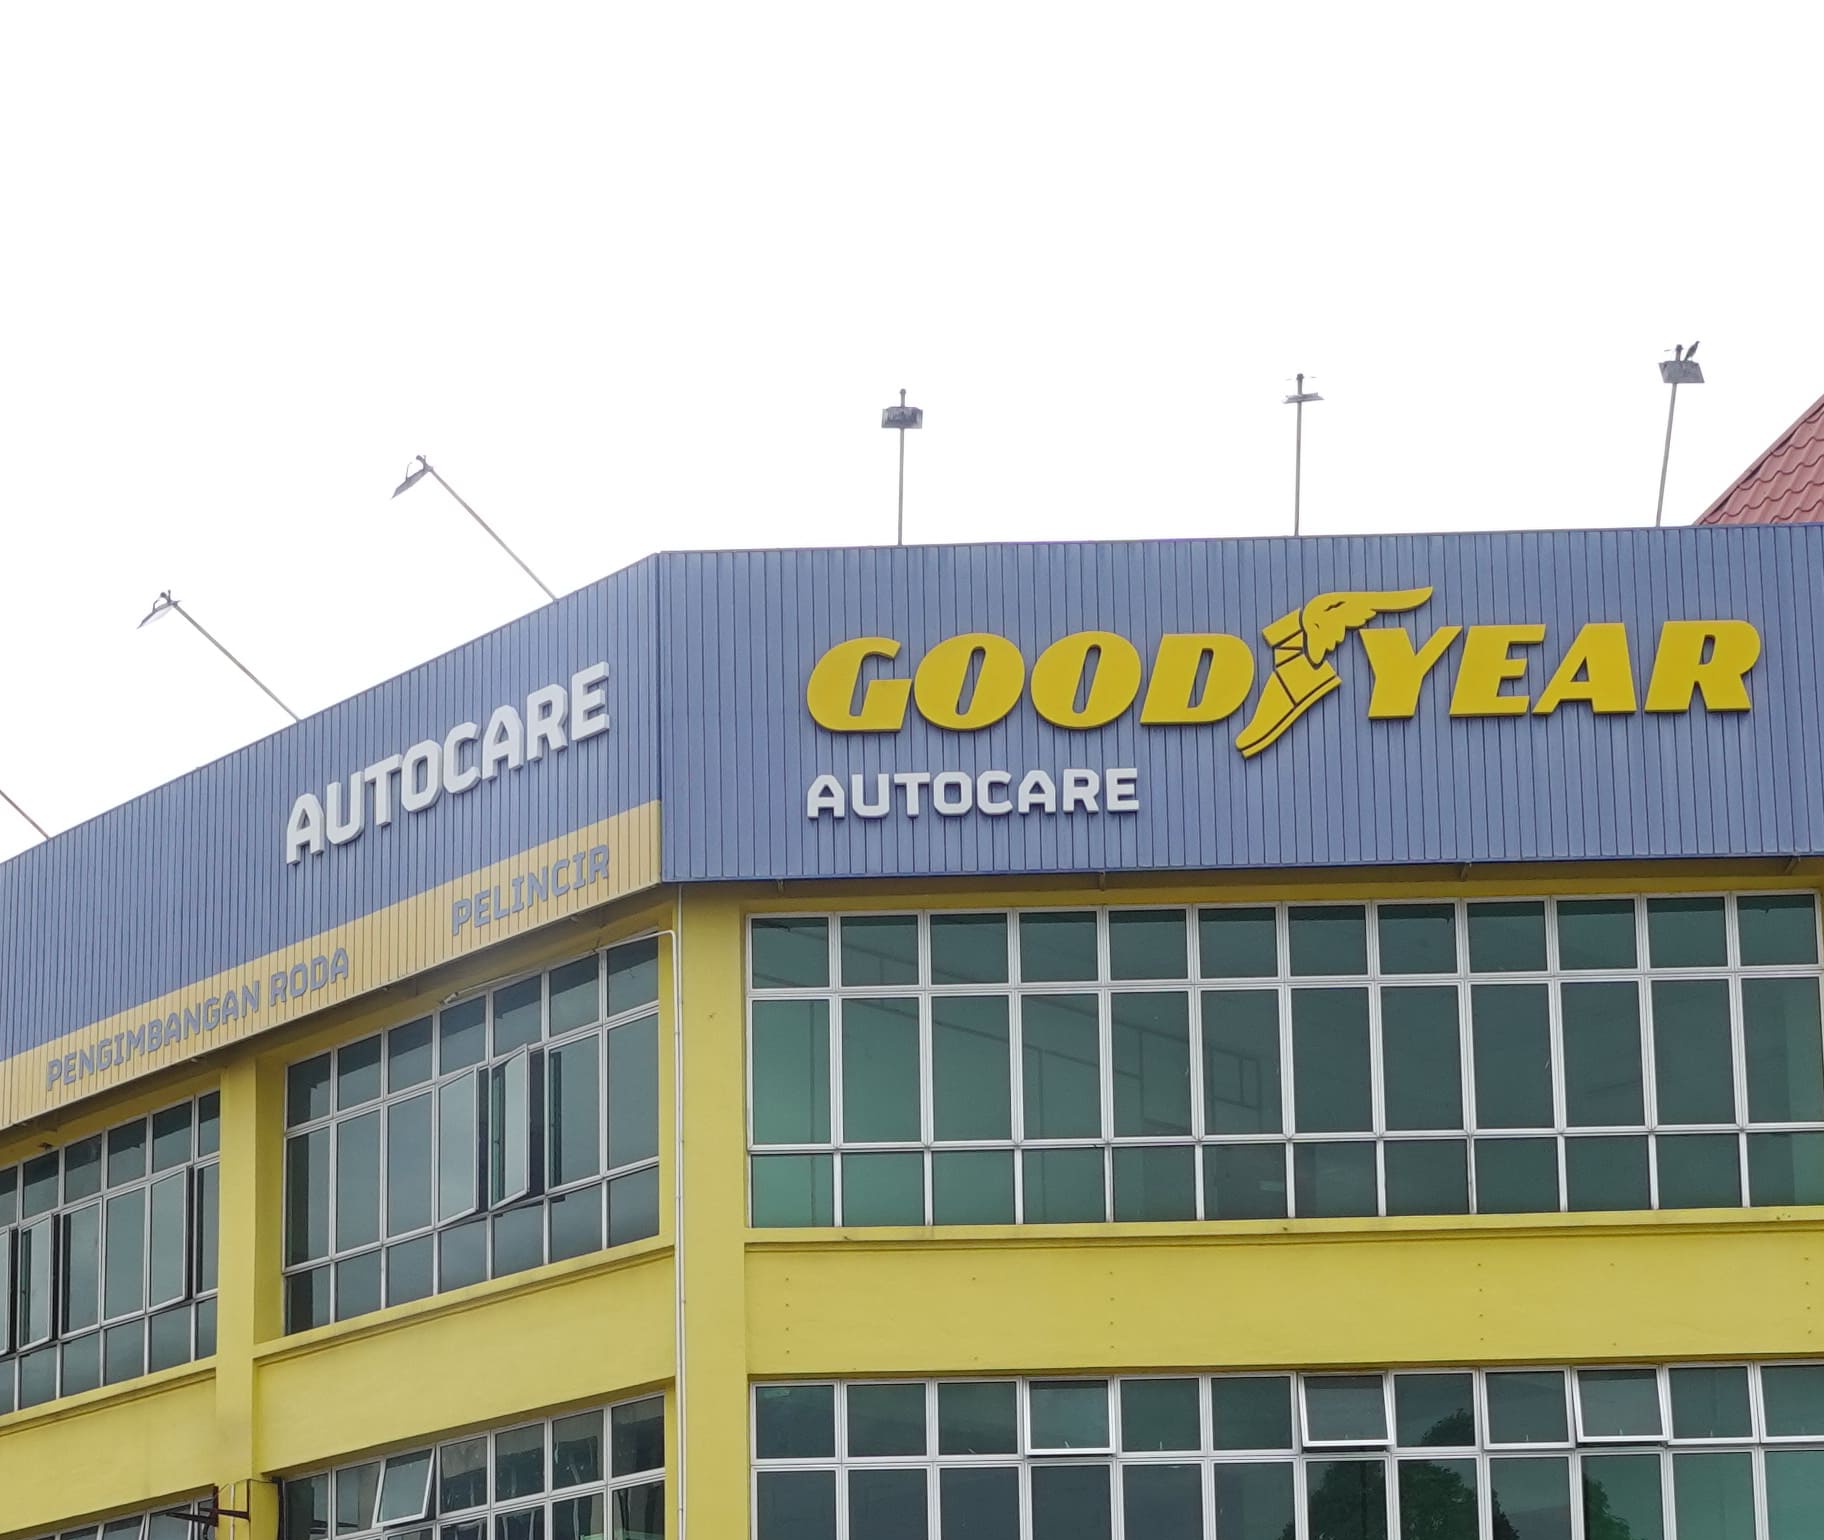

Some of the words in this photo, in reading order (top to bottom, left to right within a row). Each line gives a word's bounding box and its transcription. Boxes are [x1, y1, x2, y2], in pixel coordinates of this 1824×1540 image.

[806, 617, 1762, 735] GOODYEAR
[287, 661, 610, 865] AUTOCARE
[806, 766, 1139, 820] AUTOCARE
[452, 844, 611, 937] PELINCIR
[46, 982, 260, 1091] PENGIMBANGAN
[270, 947, 350, 1005] RODA
